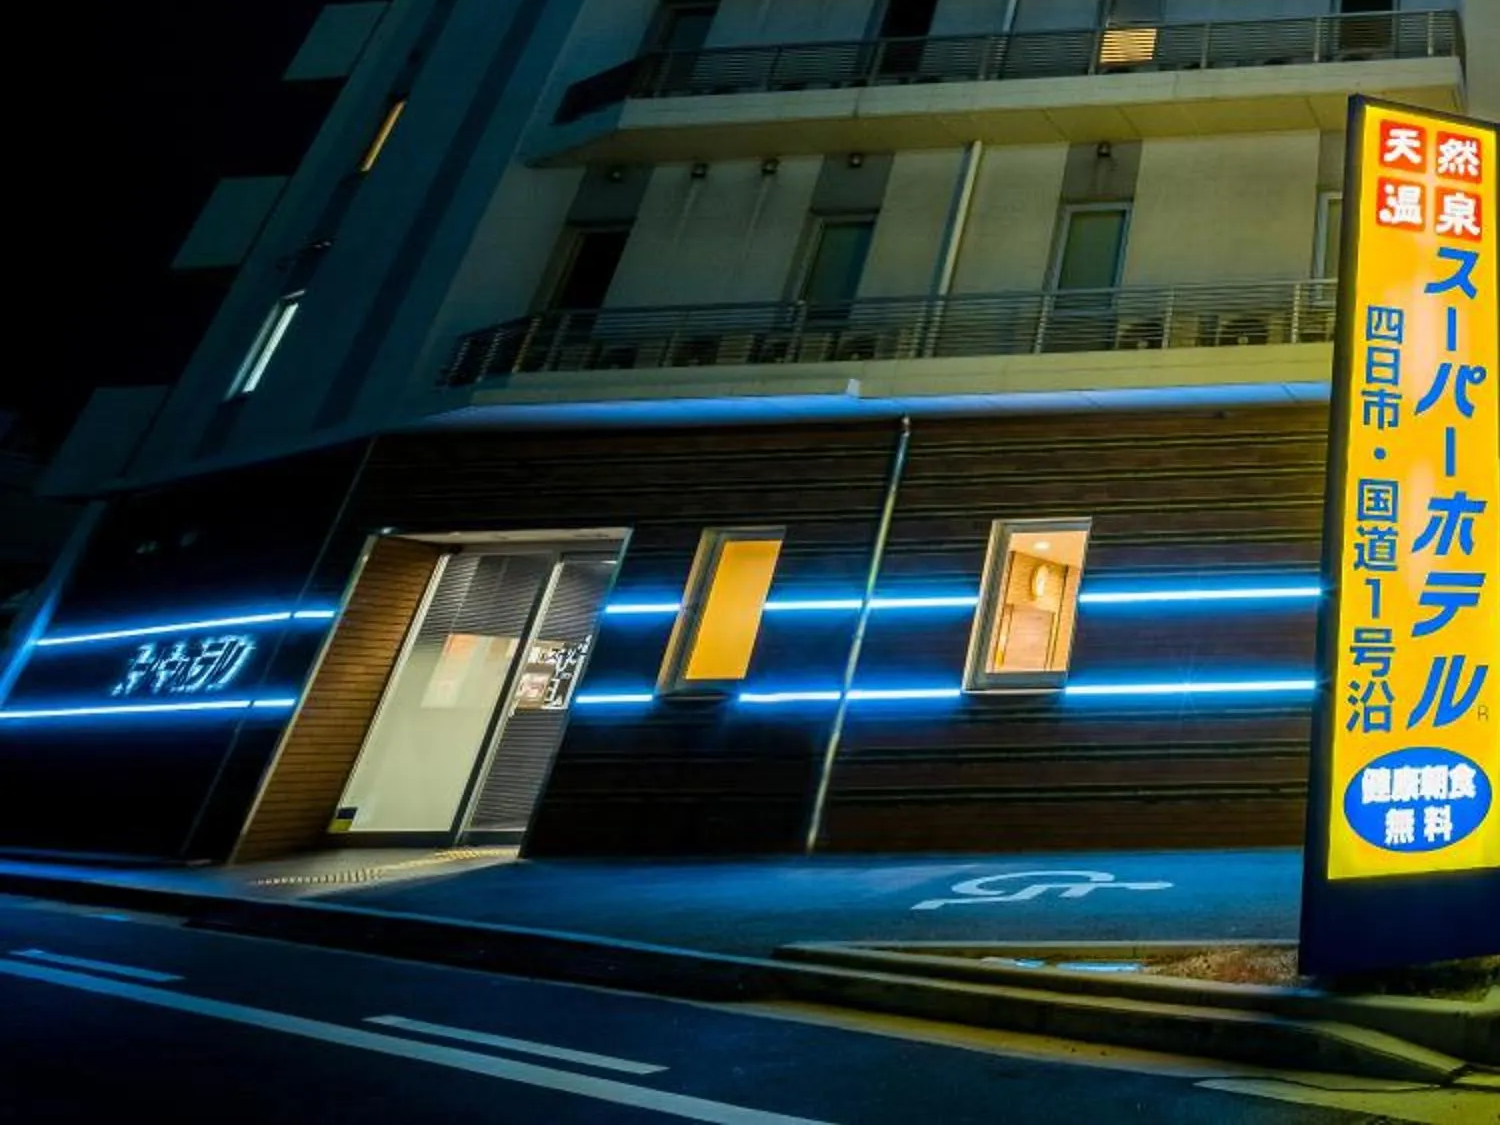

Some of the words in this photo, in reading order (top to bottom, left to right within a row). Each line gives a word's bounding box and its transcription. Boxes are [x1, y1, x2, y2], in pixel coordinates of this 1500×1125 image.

[1382, 128, 1481, 176] 天然
[1378, 183, 1481, 237] 温泉
[1405, 246, 1489, 730] スーパーホテル
[1345, 305, 1404, 733] 四日市・国道1号沿
[1362, 762, 1478, 804] 健康朝食
[1384, 805, 1453, 846] 無料
